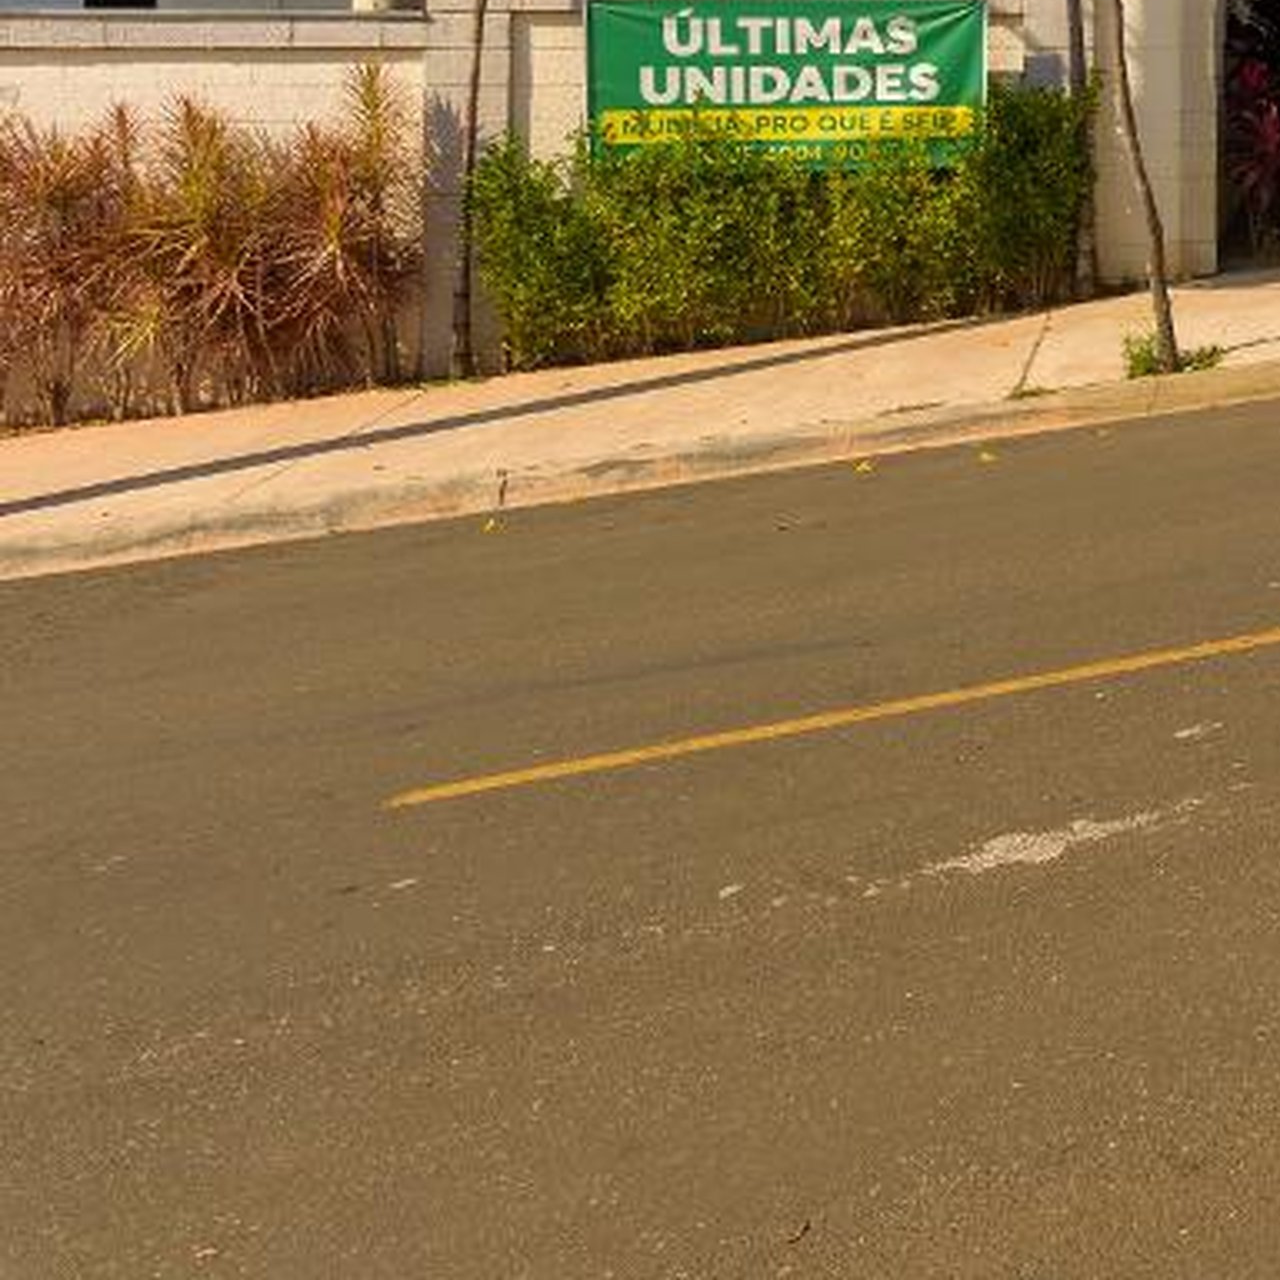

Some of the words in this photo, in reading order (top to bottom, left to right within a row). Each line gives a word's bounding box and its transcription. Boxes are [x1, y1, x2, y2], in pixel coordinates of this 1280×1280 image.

[661, 9, 917, 56] ÚLTIMAS
[639, 63, 940, 105] UNIDADES
[756, 115, 810, 134] PRO
[818, 114, 872, 131] QUE
[879, 110, 894, 131] É
